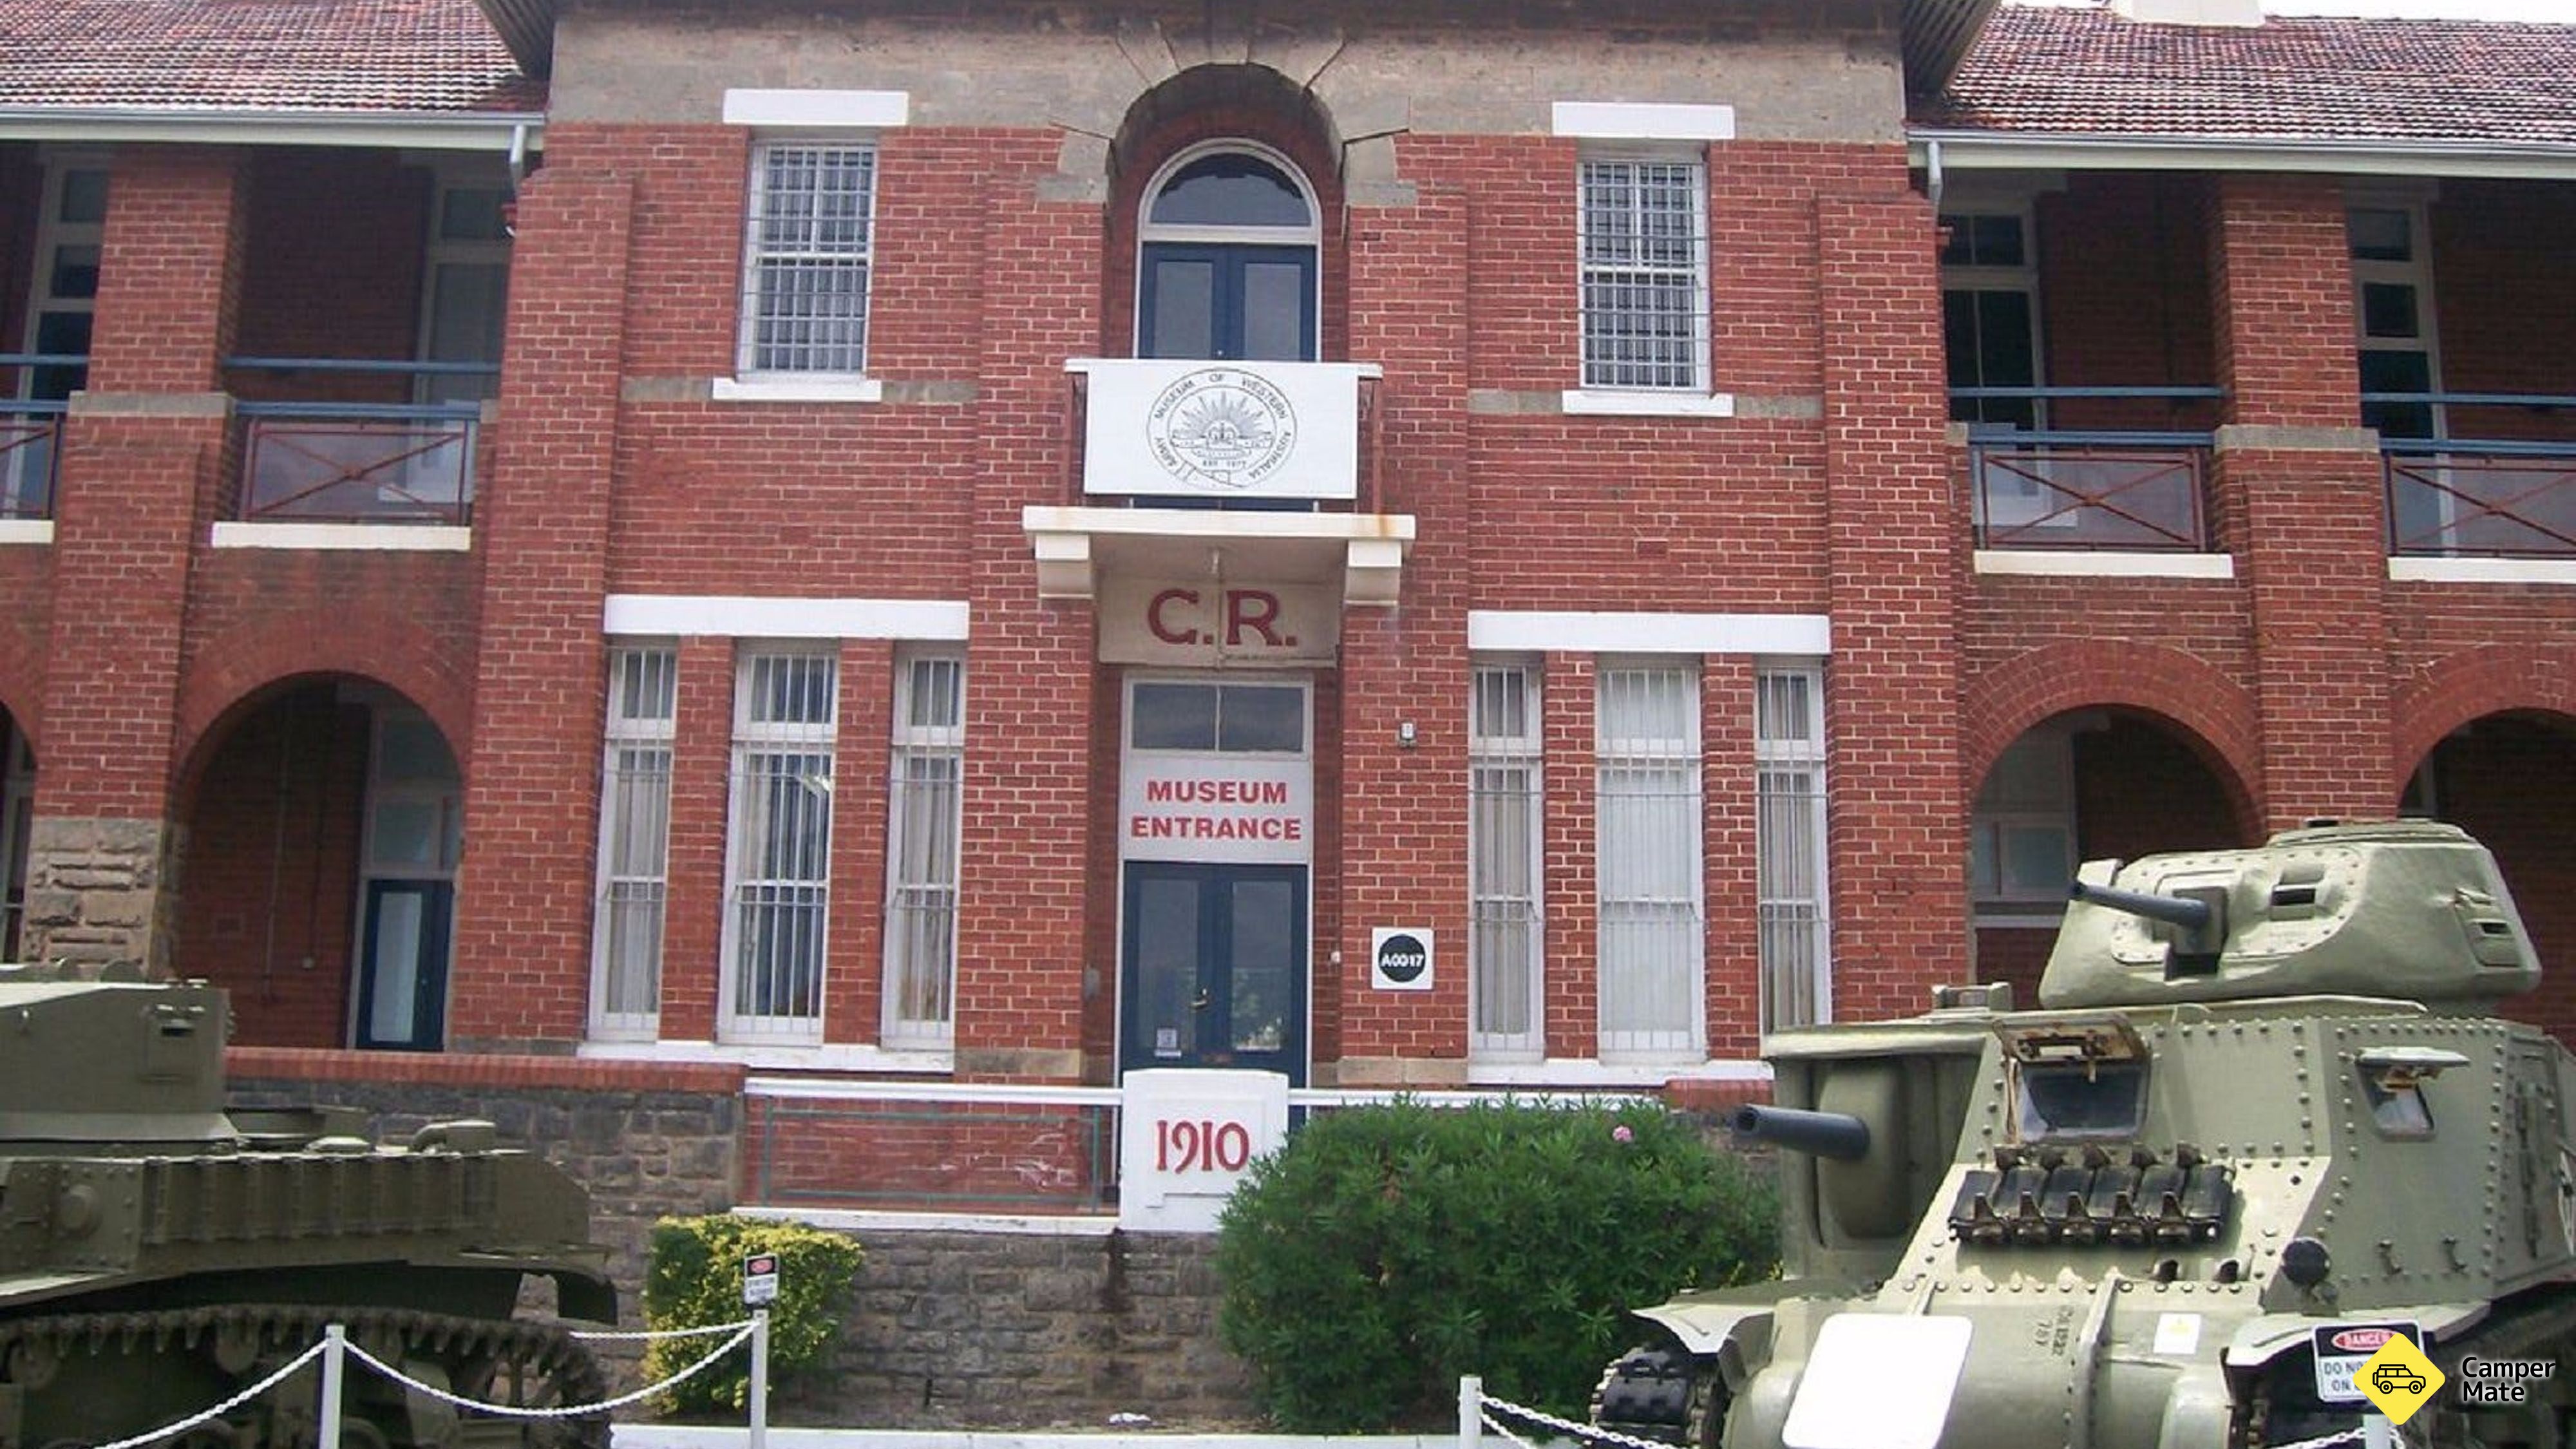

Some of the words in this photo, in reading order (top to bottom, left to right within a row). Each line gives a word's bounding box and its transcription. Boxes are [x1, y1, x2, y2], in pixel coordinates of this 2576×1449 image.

[1208, 373, 1225, 383] OF
[1154, 380, 1196, 419] MUSEUM
[1242, 377, 1288, 419] WESTERN
[1248, 430, 1292, 478] AUSTRALIA
[1146, 781, 1287, 804] MUSEUM
[1131, 815, 1302, 840] ENTRANCE
[1381, 952, 1425, 967] A0017
[1157, 1119, 1250, 1175] 1910
[2324, 1361, 2342, 1375] DO
[2345, 1361, 2364, 1374] NO
